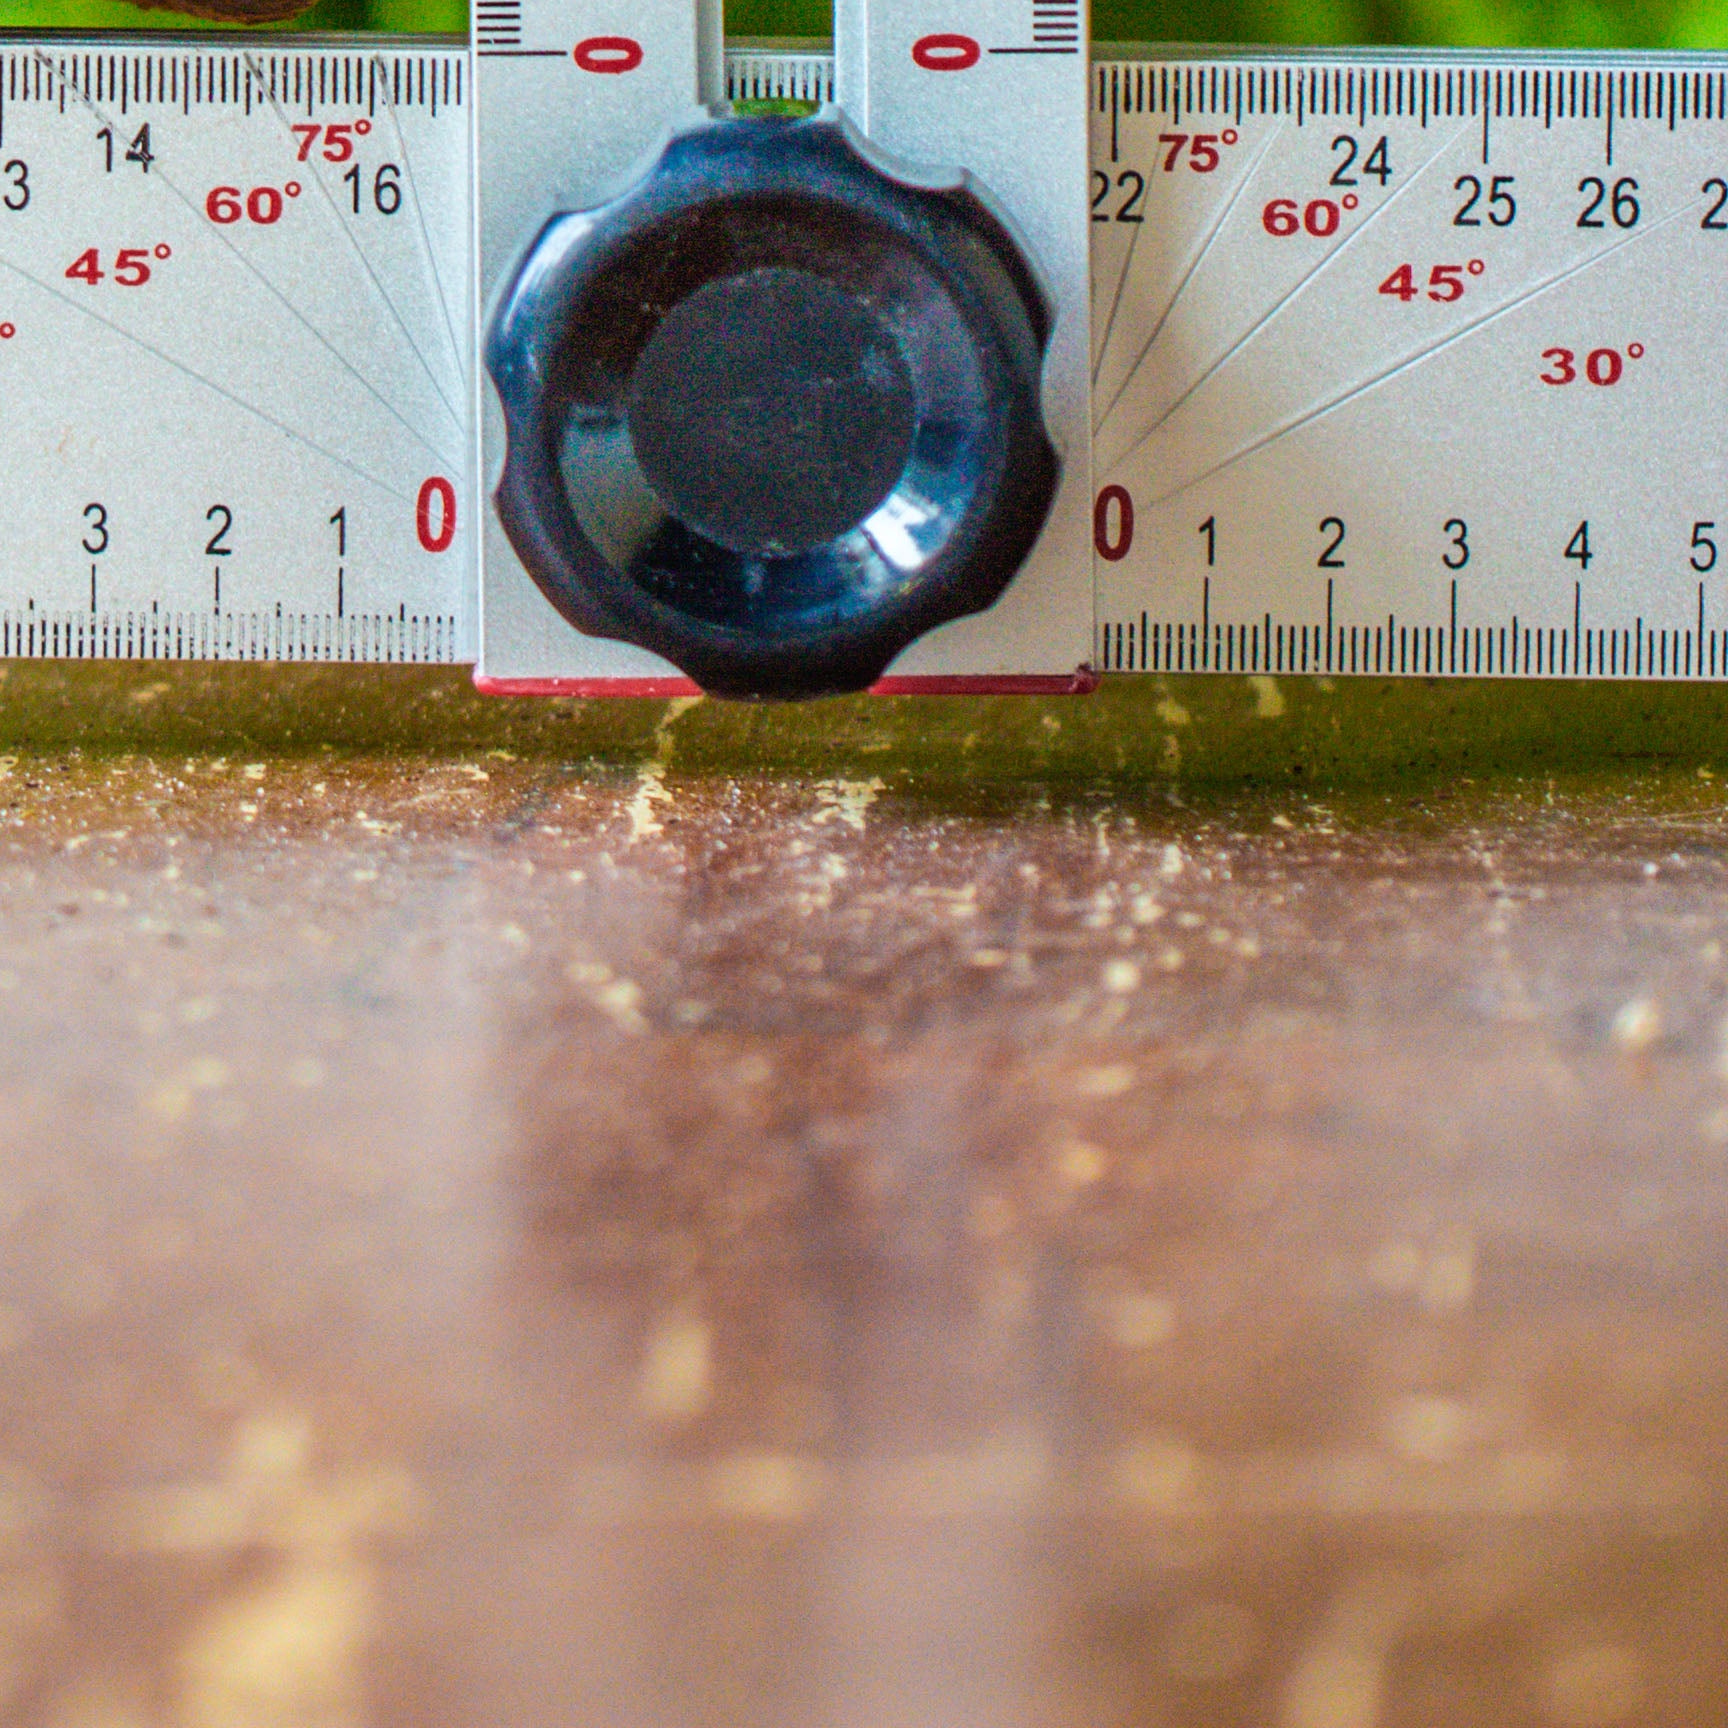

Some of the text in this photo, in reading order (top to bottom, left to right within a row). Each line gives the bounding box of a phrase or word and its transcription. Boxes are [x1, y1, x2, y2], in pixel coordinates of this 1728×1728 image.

[573, 36, 644, 75] 0
[912, 33, 981, 71] 0
[291, 119, 372, 162] 75°
[1159, 129, 1238, 172] 75°
[96, 123, 155, 173] 14
[344, 163, 402, 215] 16
[1329, 136, 1393, 186] 24
[1453, 174, 1516, 227] 25
[1576, 176, 1639, 229] 26
[1701, 177, 1728, 230] 2
[206, 181, 301, 224] 60°
[1262, 194, 1359, 237] 60°
[65, 244, 171, 286] 45°
[1379, 259, 1484, 303] 45°
[1540, 343, 1644, 386] 30°
[82, 502, 109, 554] 3
[205, 504, 232, 556] 2
[330, 506, 345, 556] 1
[416, 478, 456, 553] 0
[1094, 485, 1716, 572] 0 1 2 3 4 5
